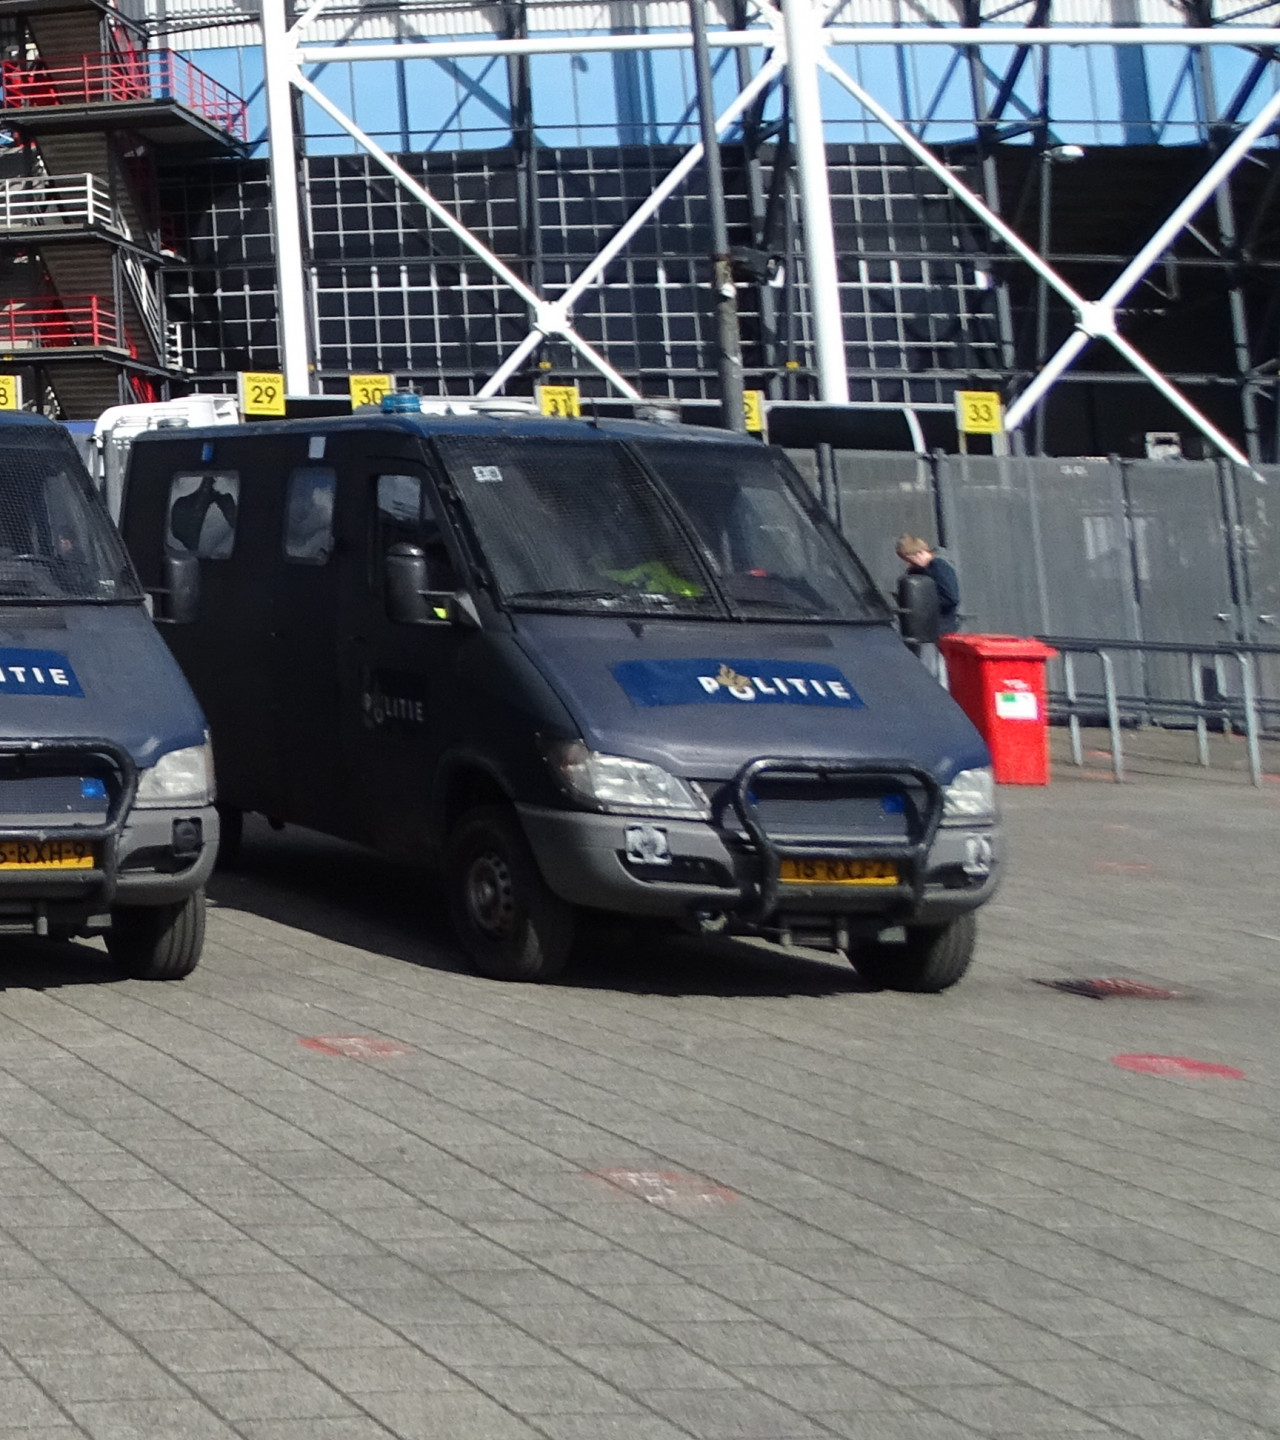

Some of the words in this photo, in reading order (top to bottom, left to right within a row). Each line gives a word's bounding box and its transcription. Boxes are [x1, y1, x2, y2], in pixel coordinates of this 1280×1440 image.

[247, 376, 280, 384] INGANG
[251, 386, 277, 404] 29
[359, 388, 383, 406] 30
[968, 403, 993, 422] 33
[697, 676, 851, 701] POLITIE
